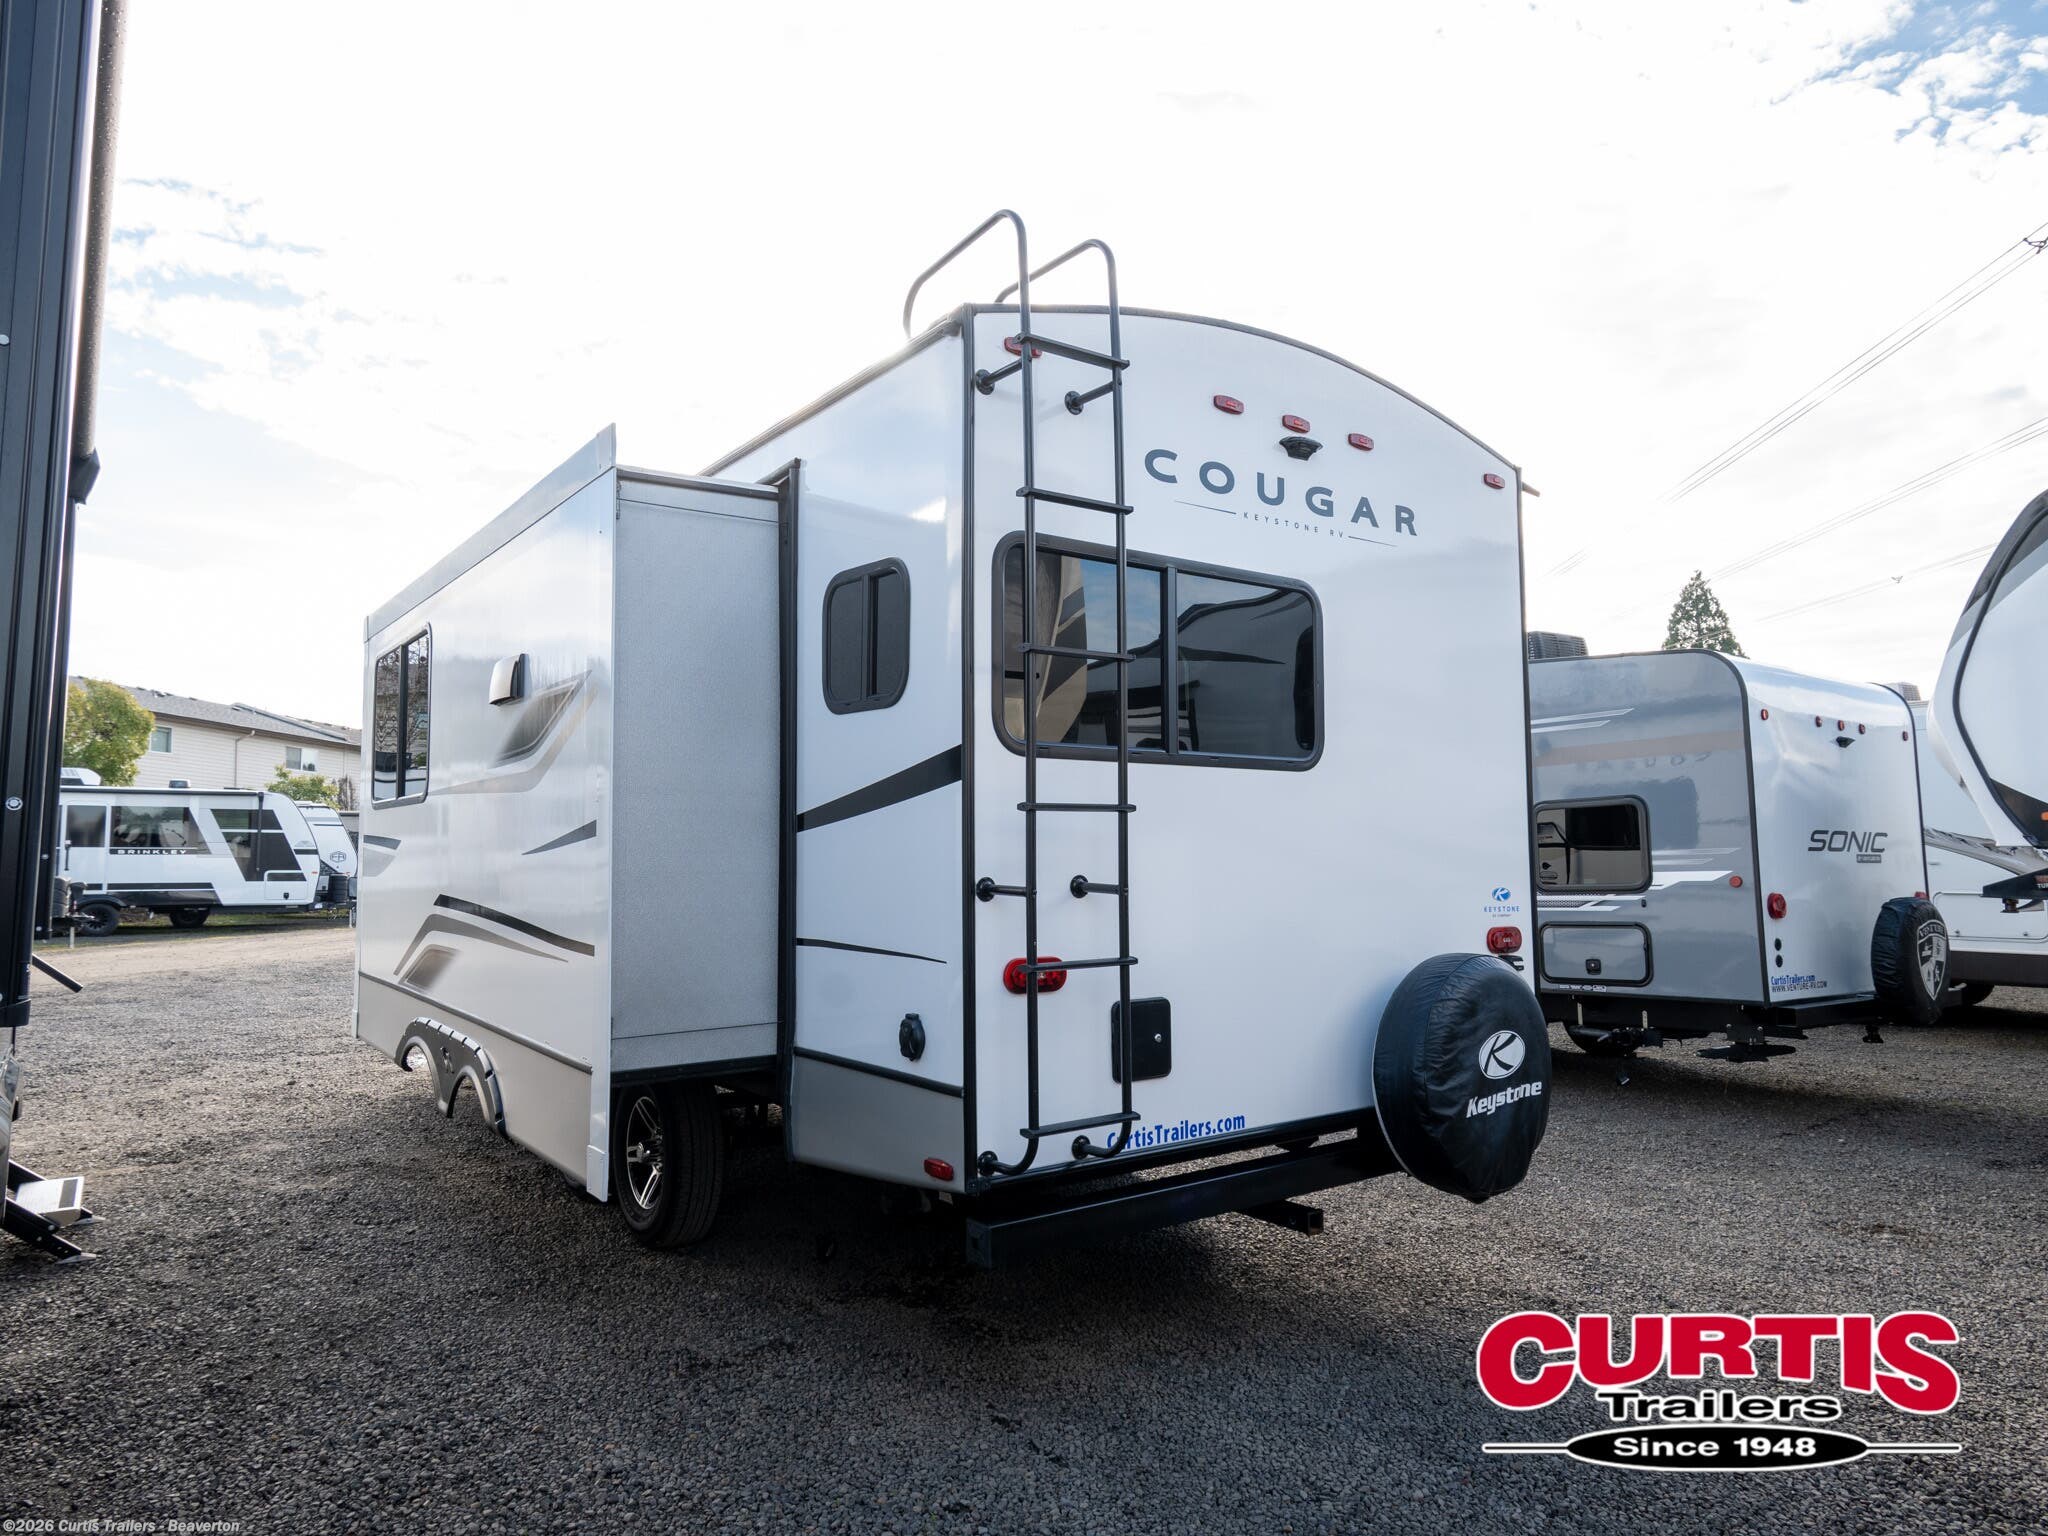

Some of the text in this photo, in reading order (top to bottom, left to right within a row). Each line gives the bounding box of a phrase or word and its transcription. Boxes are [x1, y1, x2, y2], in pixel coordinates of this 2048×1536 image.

[1144, 449, 1417, 536] COUGAR
[1243, 511, 1343, 538] KEYSTONE RV
[1808, 829, 1888, 853] SONIC
[1483, 904, 1521, 913] KEYSTONE
[1771, 974, 1816, 986] CurtisTrailers.com
[1465, 1080, 1543, 1119] Keystone
[1106, 1114, 1246, 1150] CrtisTrailers.com
